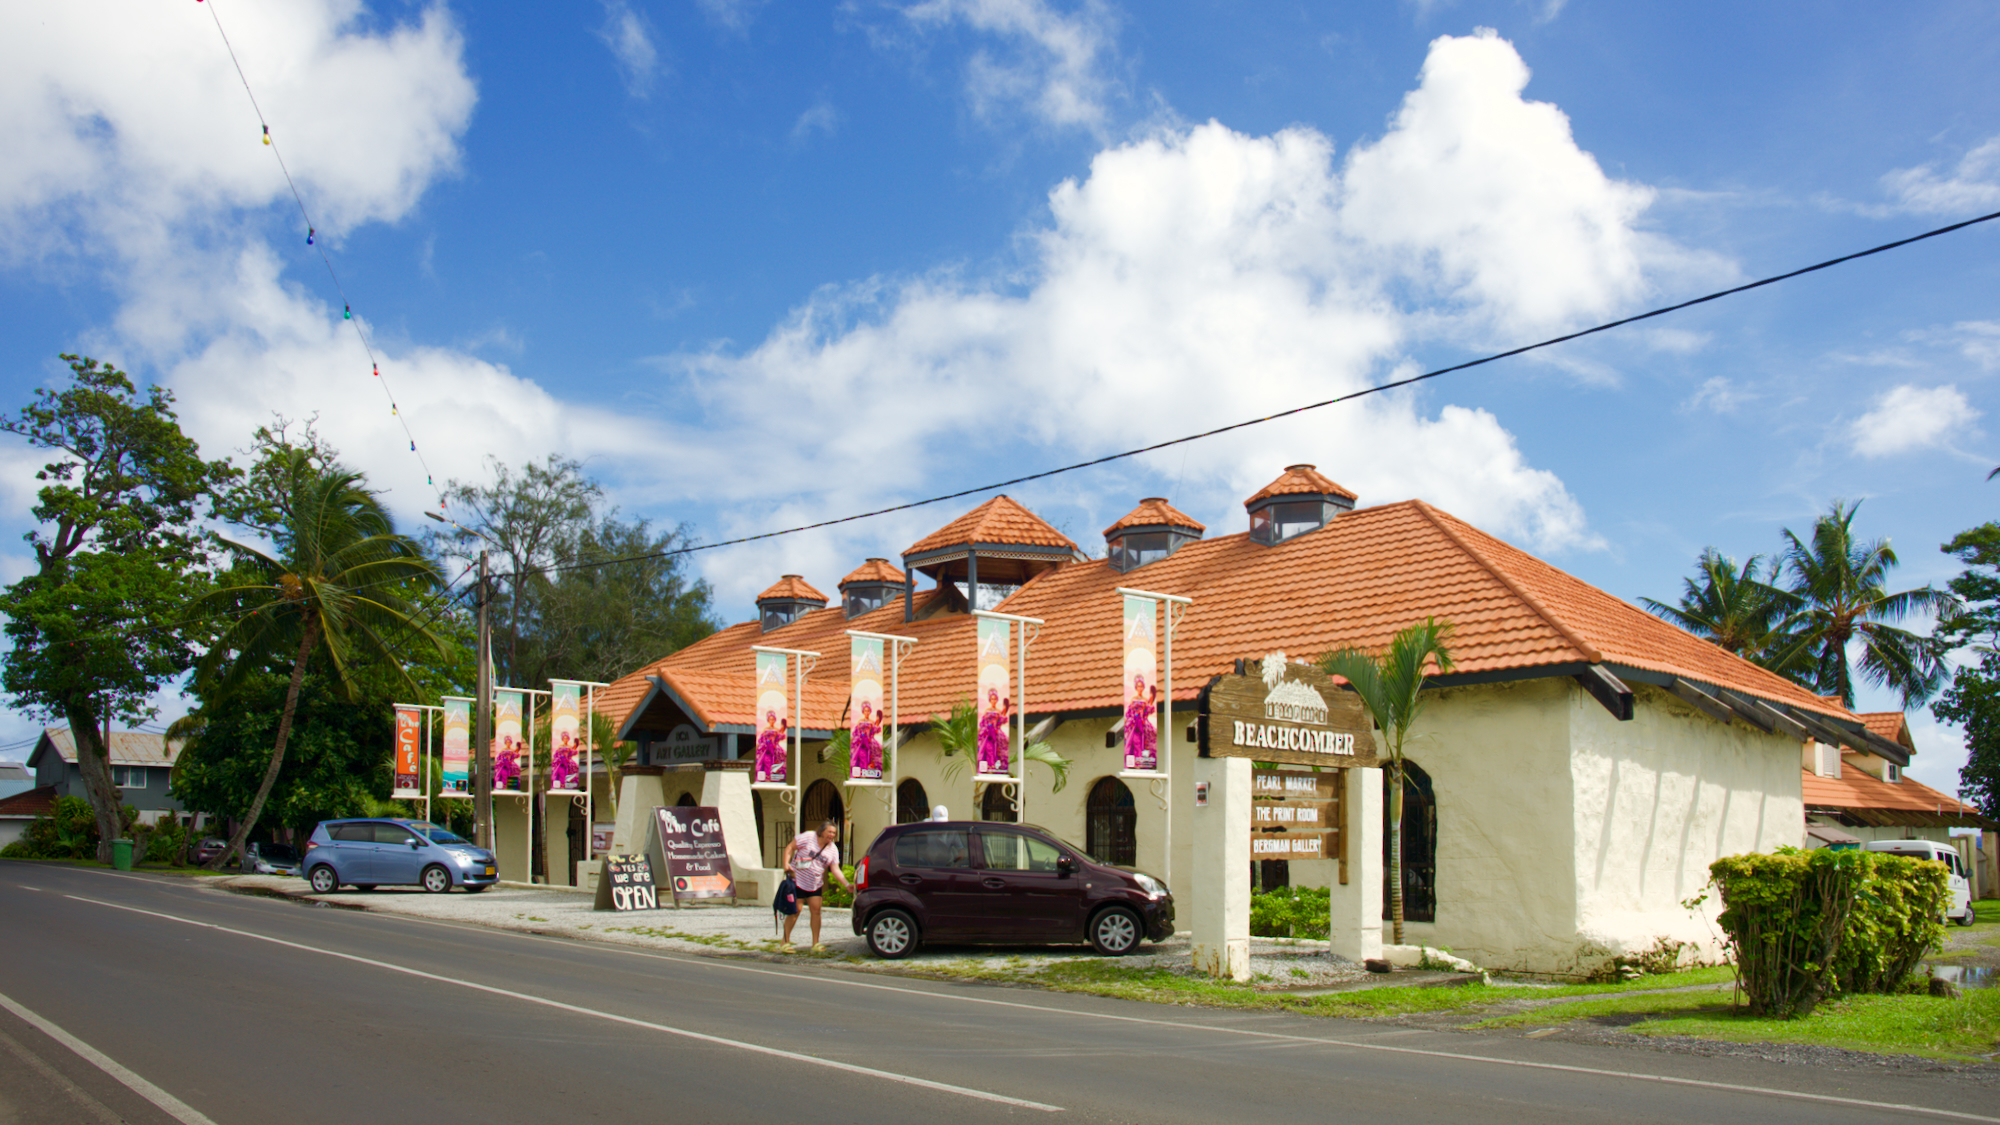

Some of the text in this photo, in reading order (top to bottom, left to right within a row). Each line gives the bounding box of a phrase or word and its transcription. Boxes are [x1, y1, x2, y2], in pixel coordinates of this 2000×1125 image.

[1233, 720, 1355, 756] BEACHCOMBER
[656, 743, 711, 760] ART GALLERY
[1256, 775, 1318, 791] PEARL MARKET
[1256, 806, 1318, 822] THE PRINT ROOM
[691, 818, 720, 837] Café
[667, 839, 722, 850] Quality Espresso
[1253, 836, 1322, 855] BERGMAN GALLERY
[667, 851, 727, 860] Homemade Cakes
[685, 862, 711, 871] & Food
[614, 872, 651, 883] we are
[612, 884, 656, 910] OPEN
